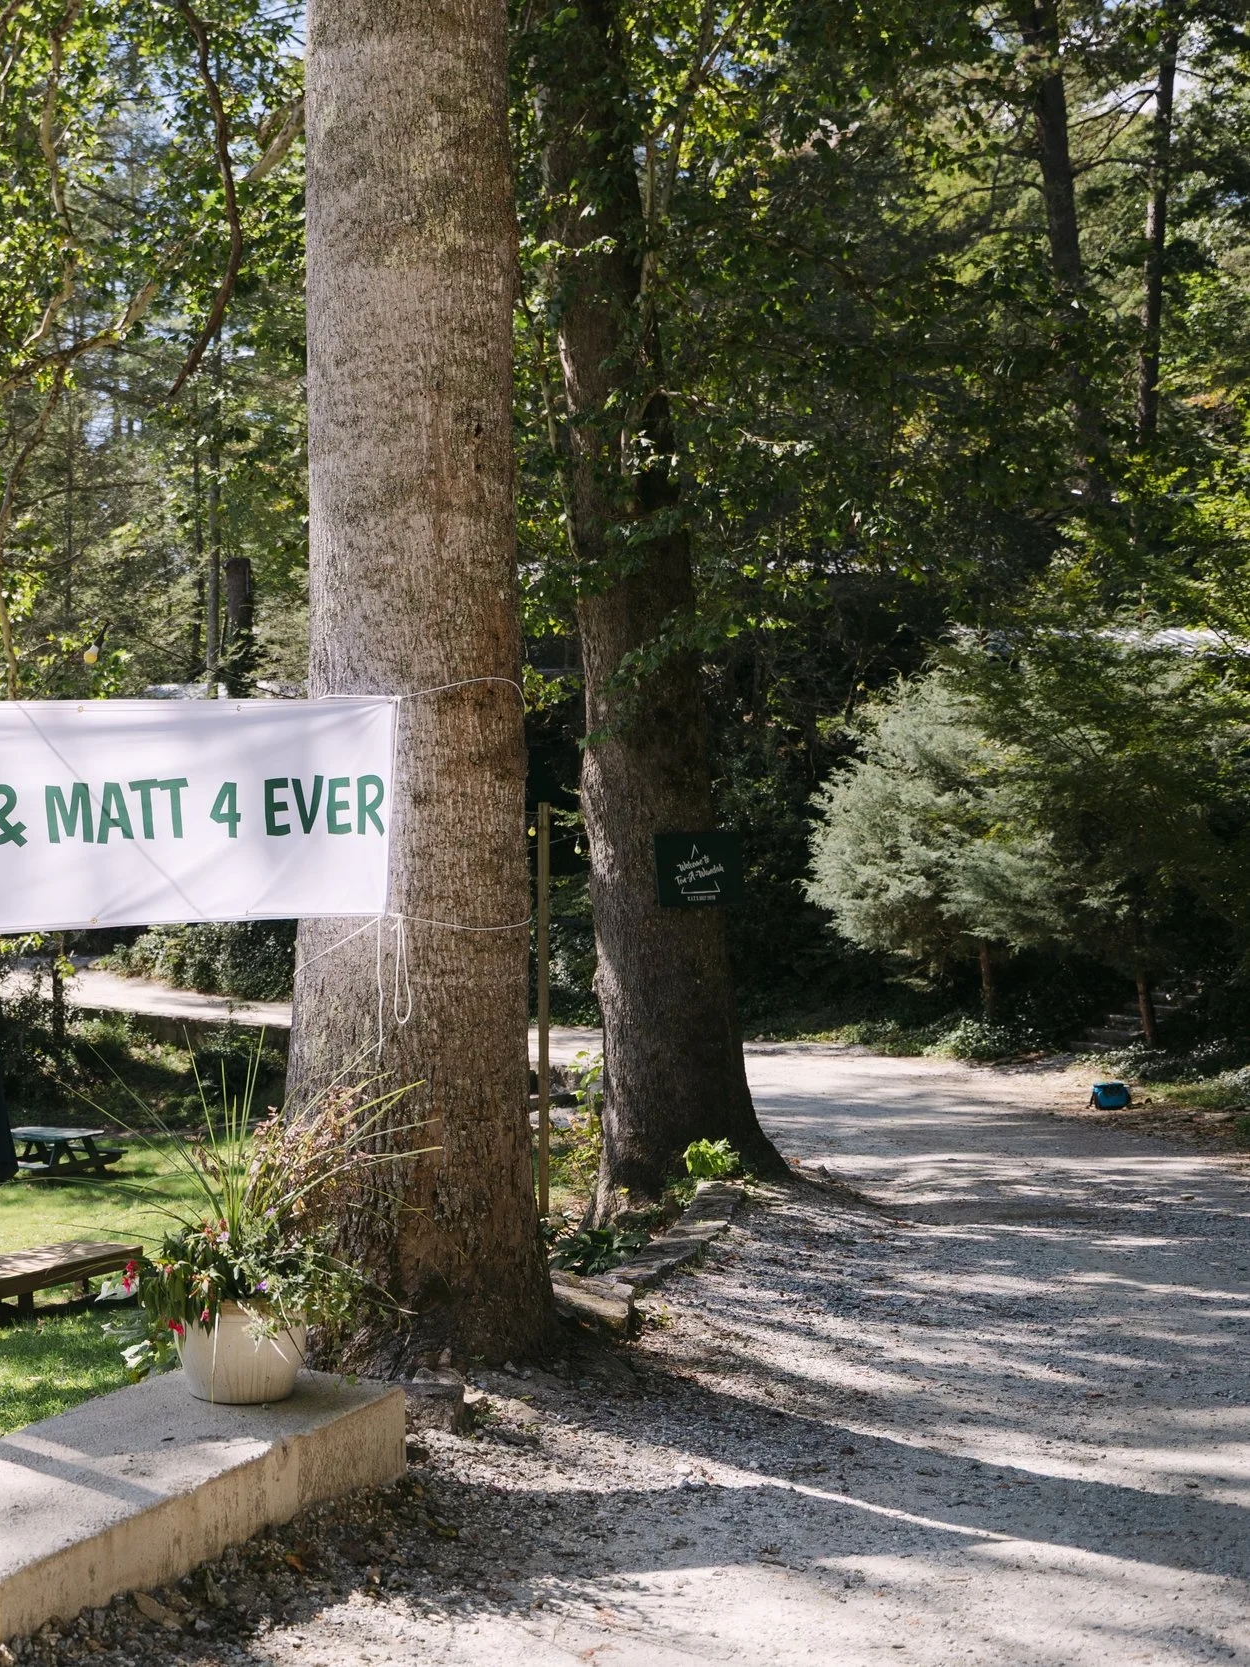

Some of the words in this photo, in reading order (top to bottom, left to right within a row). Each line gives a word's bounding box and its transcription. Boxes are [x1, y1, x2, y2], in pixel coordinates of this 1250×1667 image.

[44, 777, 189, 845] MATT
[209, 782, 241, 839] 4
[264, 774, 386, 838] EVER
